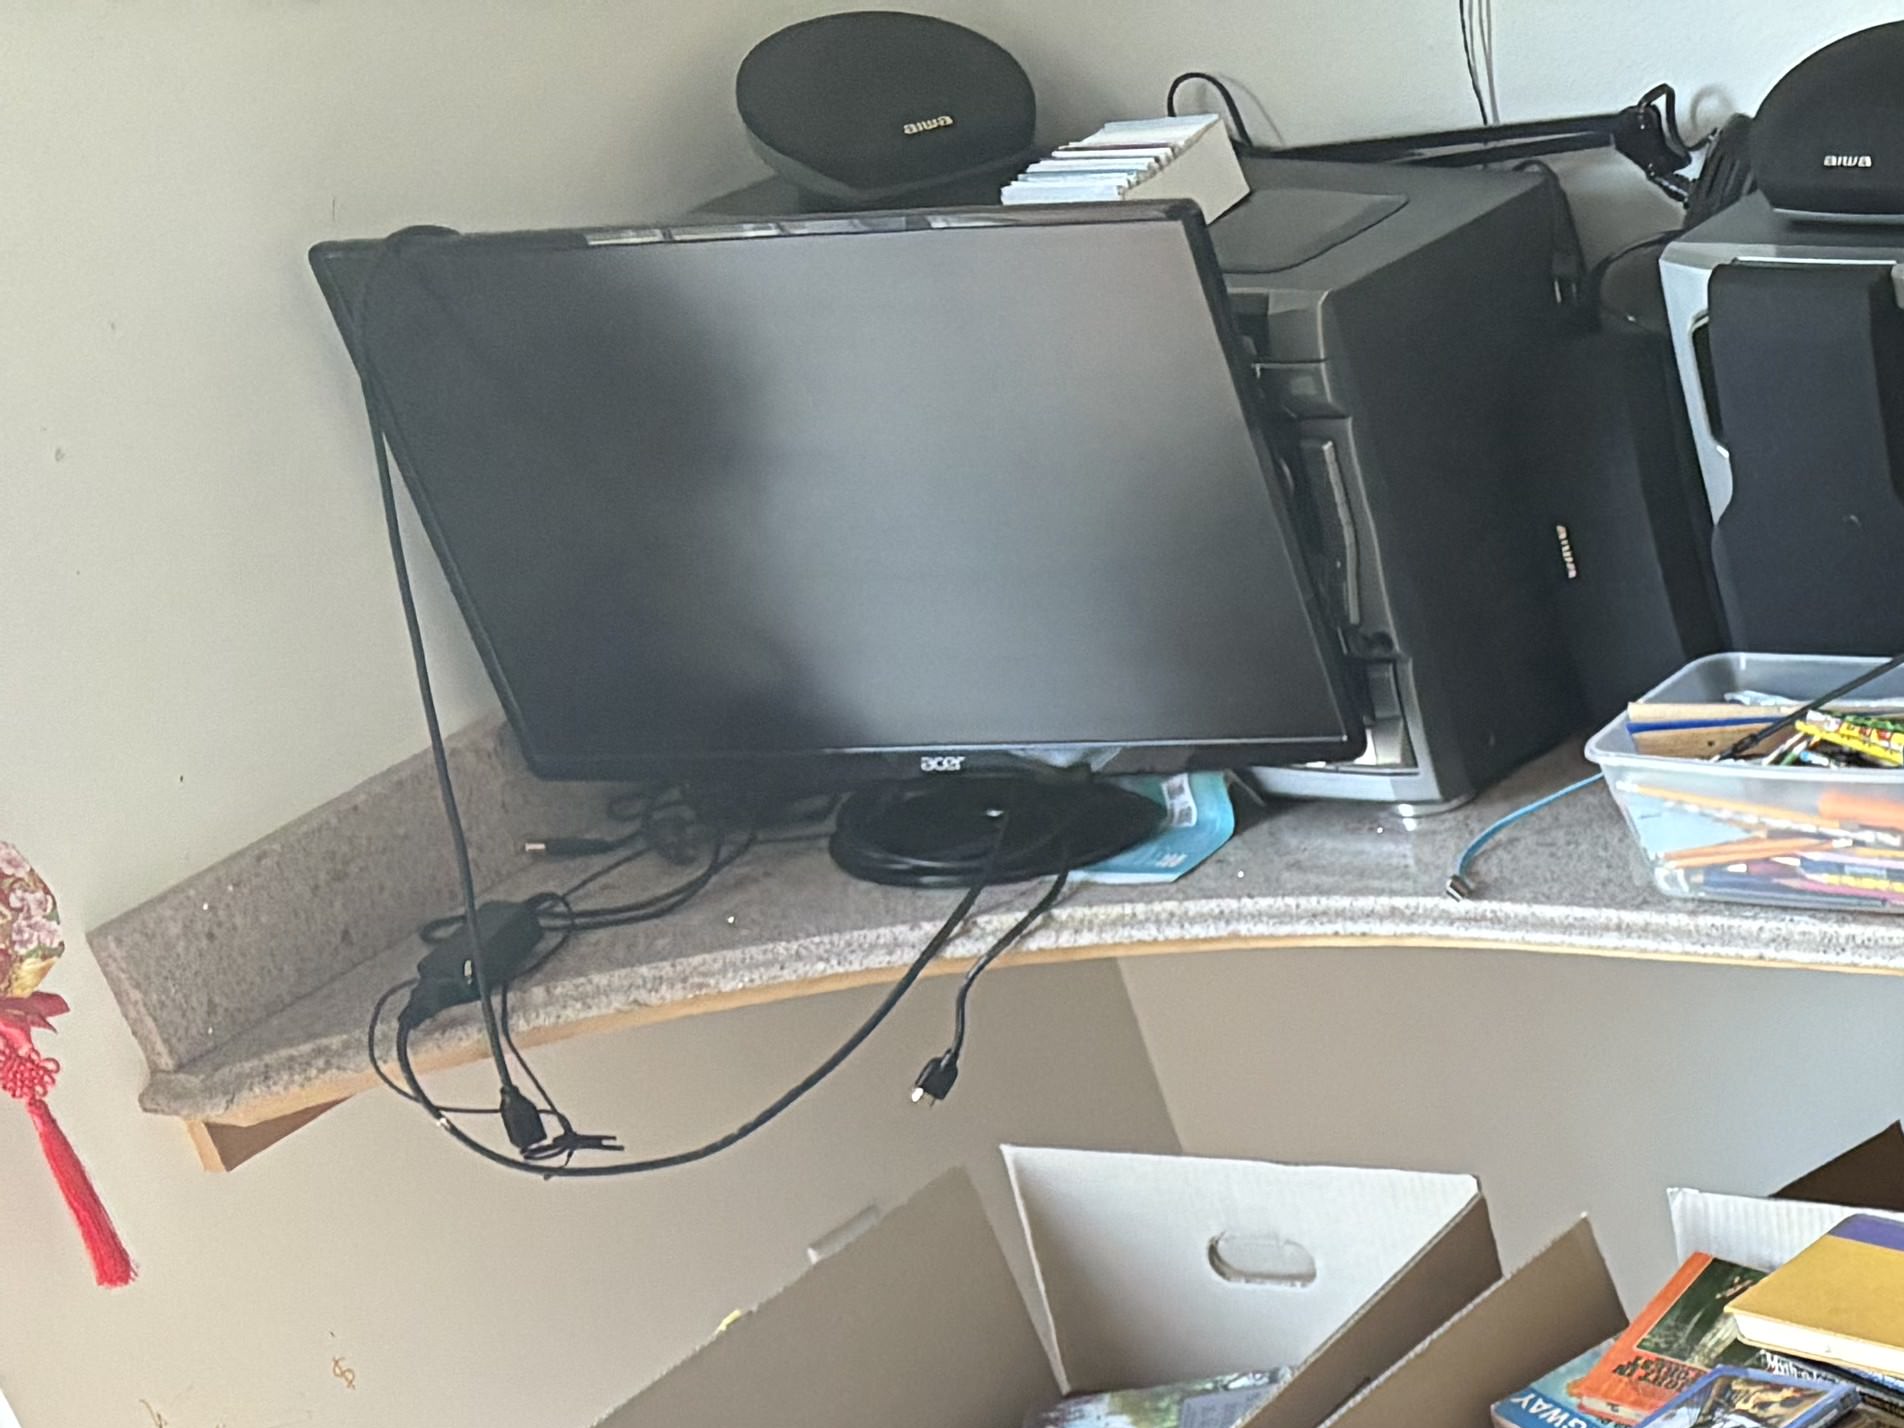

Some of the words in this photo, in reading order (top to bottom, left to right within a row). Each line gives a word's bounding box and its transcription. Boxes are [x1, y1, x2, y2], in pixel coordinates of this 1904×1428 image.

[903, 115, 953, 134] aiwa
[1823, 155, 1872, 168] aiwa
[1556, 525, 1577, 578] aiwa
[920, 756, 966, 771] acer
